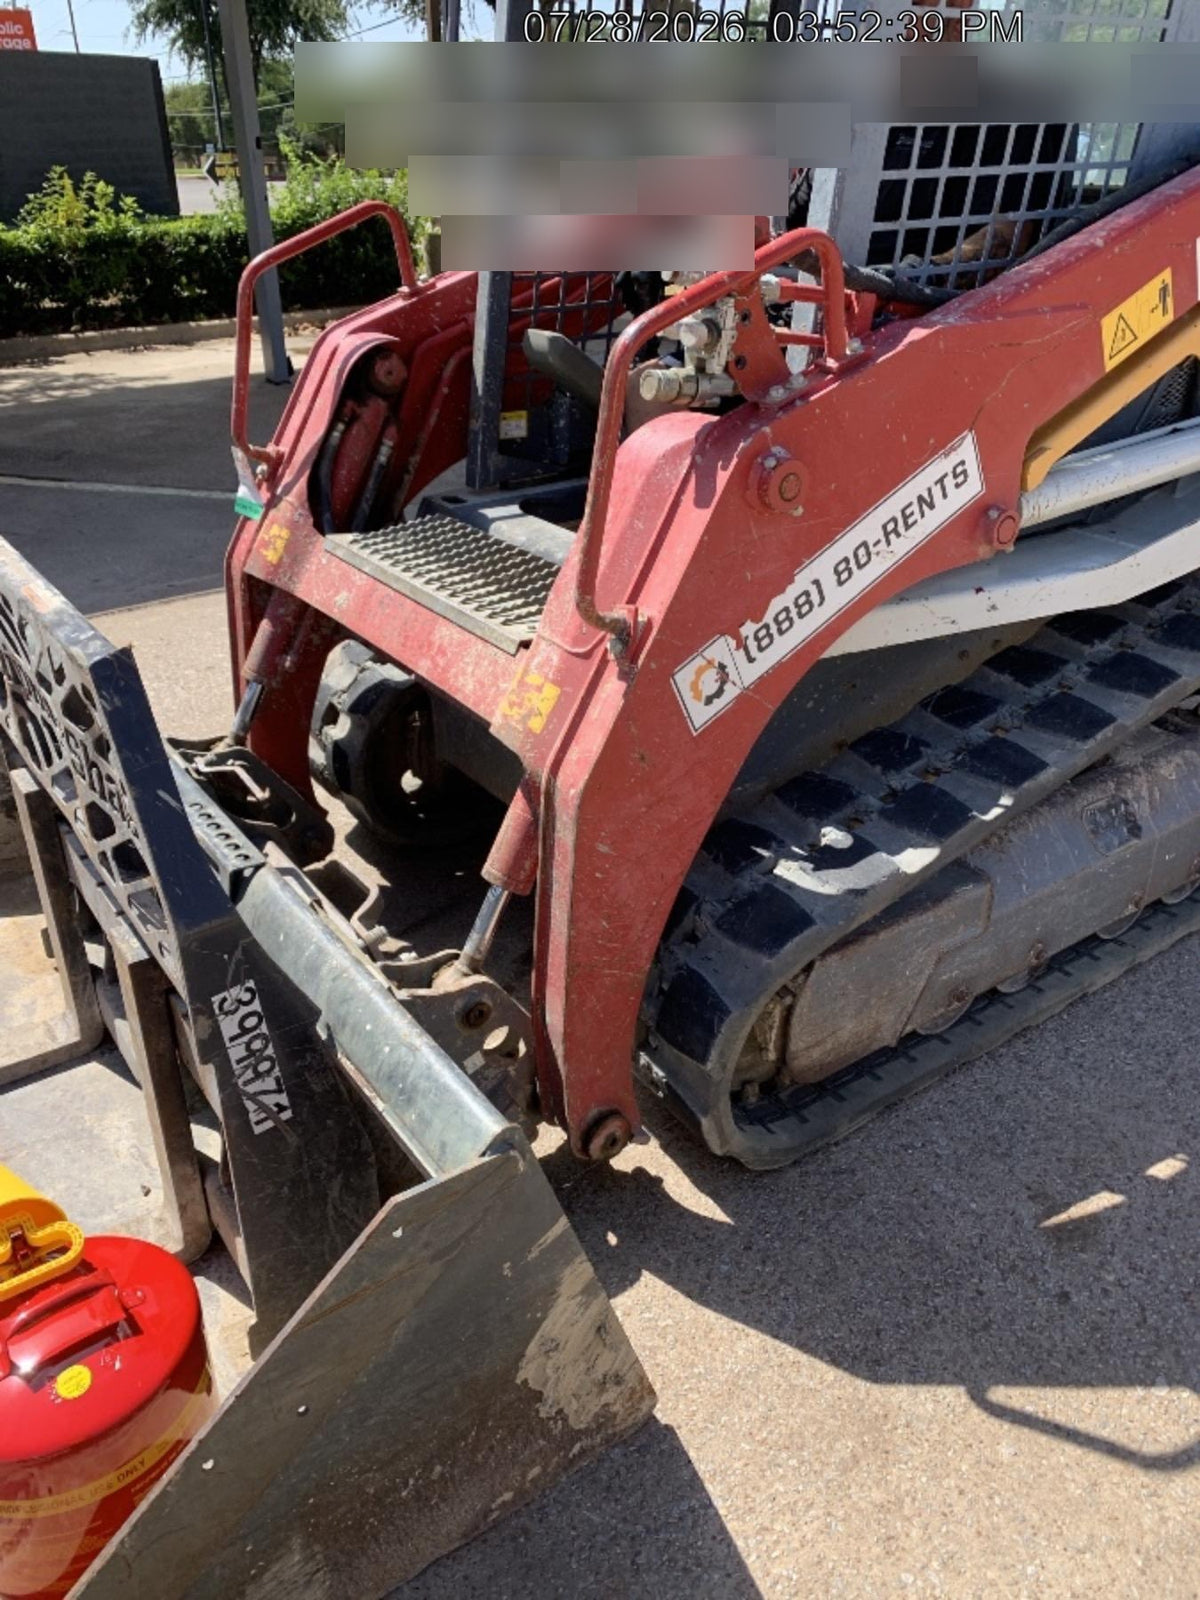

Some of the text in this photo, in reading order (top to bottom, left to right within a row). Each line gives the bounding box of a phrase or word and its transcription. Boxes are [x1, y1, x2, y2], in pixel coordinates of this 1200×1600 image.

[742, 459, 970, 664] (888) 80-RENTS
[116, 1458, 146, 1483] ONLY
